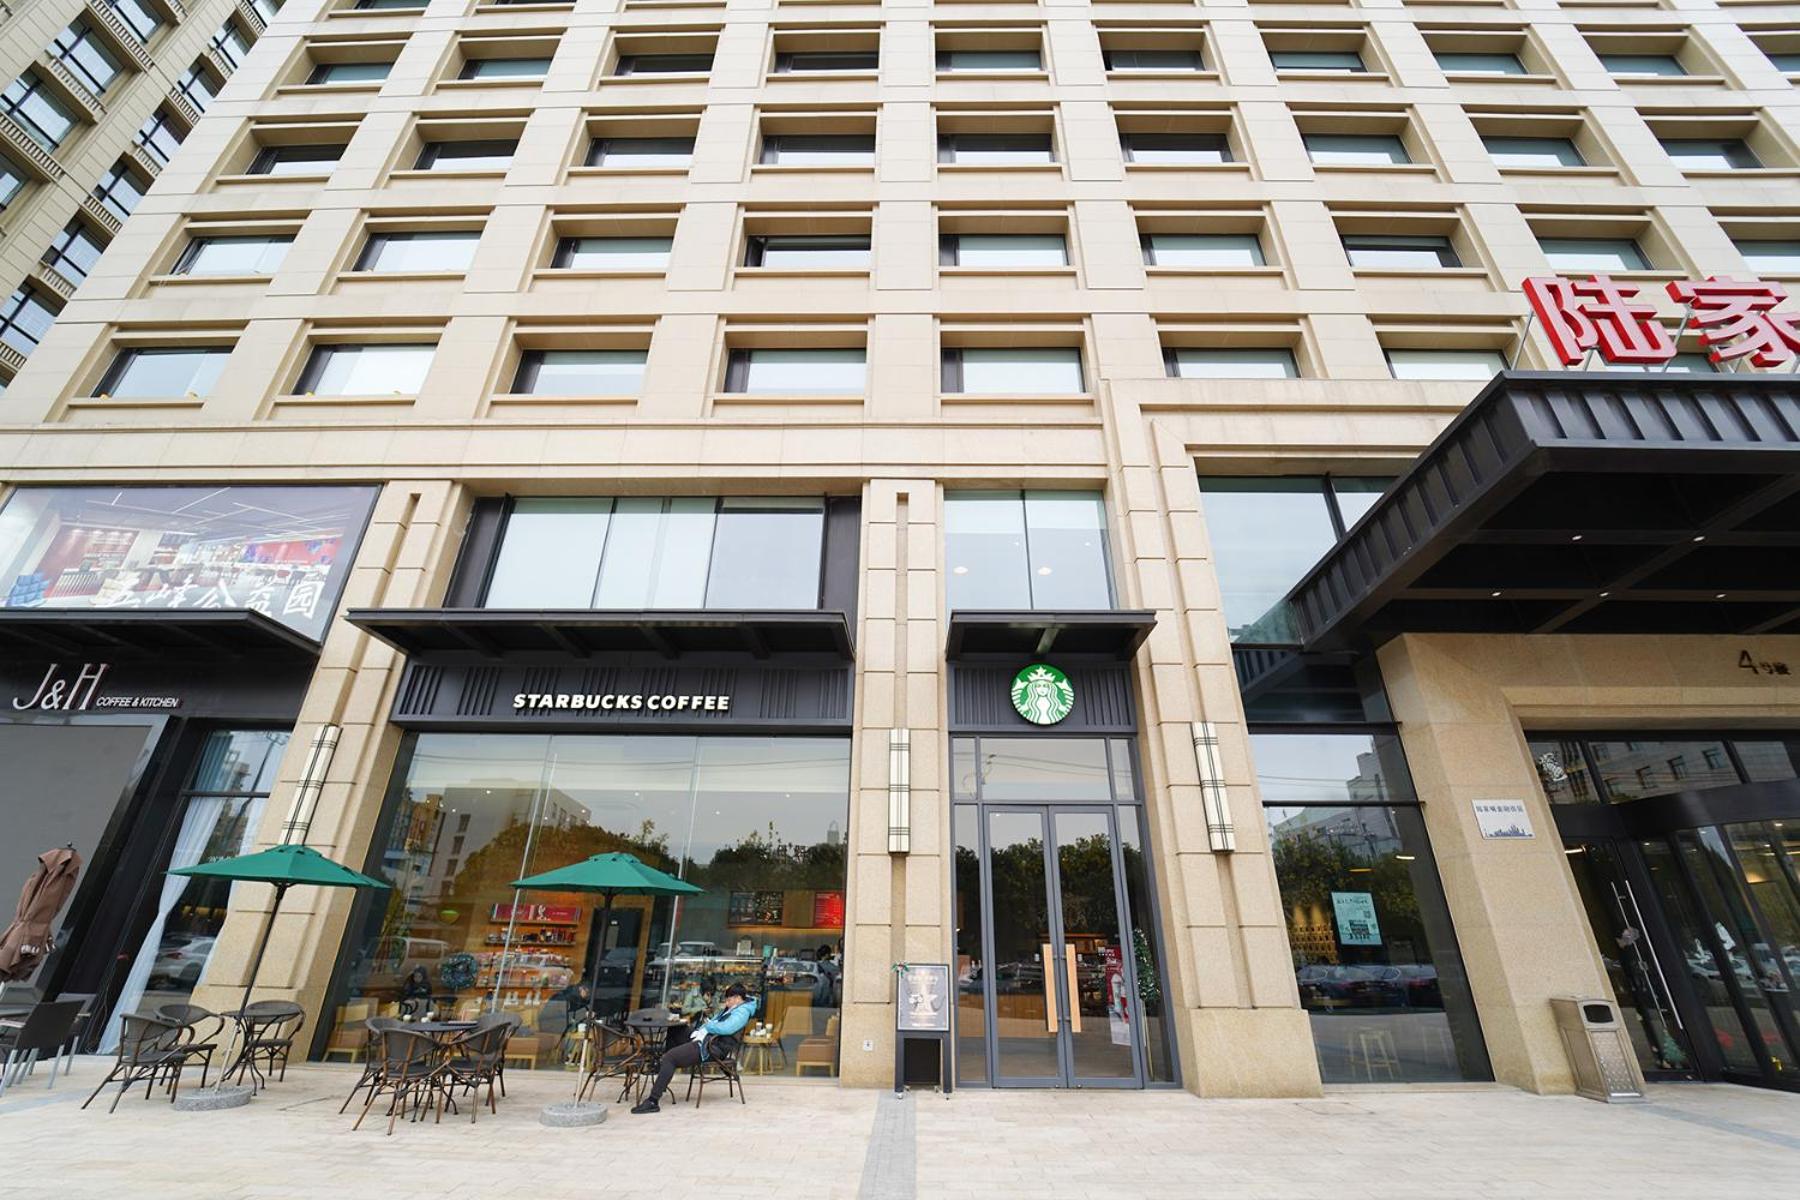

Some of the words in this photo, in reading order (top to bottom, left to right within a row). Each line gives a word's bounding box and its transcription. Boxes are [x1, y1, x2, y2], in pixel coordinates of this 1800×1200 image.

[12, 662, 108, 710] J&H
[96, 696, 132, 708] COFFEE
[131, 696, 140, 708] &
[140, 696, 179, 709] KITCHEN
[512, 693, 643, 710] STARBUCKS
[646, 694, 730, 711] COFFEE
